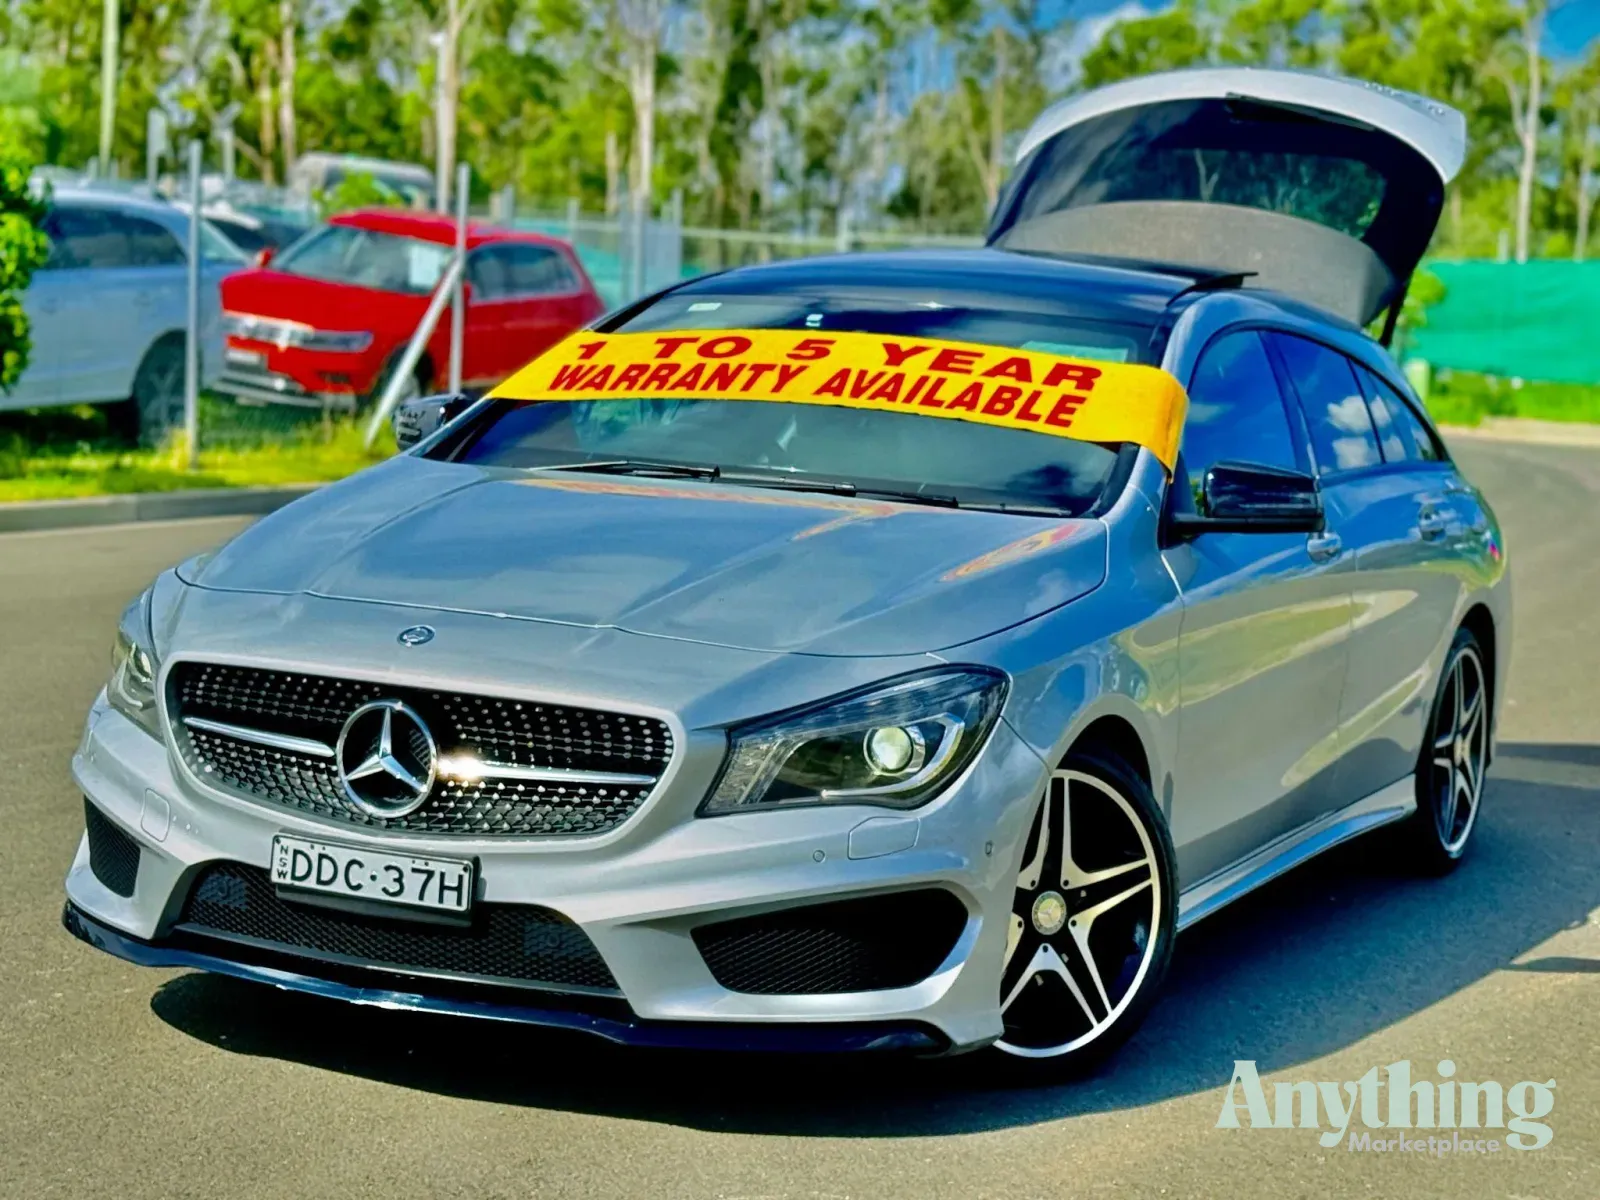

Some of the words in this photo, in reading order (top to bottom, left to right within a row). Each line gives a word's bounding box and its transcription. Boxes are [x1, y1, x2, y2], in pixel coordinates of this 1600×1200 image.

[577, 341, 608, 360] 1
[653, 335, 753, 360] TO
[785, 339, 837, 361] 5
[881, 342, 1104, 392] YEAR
[546, 363, 810, 395] WARRANTY
[812, 367, 1088, 429] AVAILABLE
